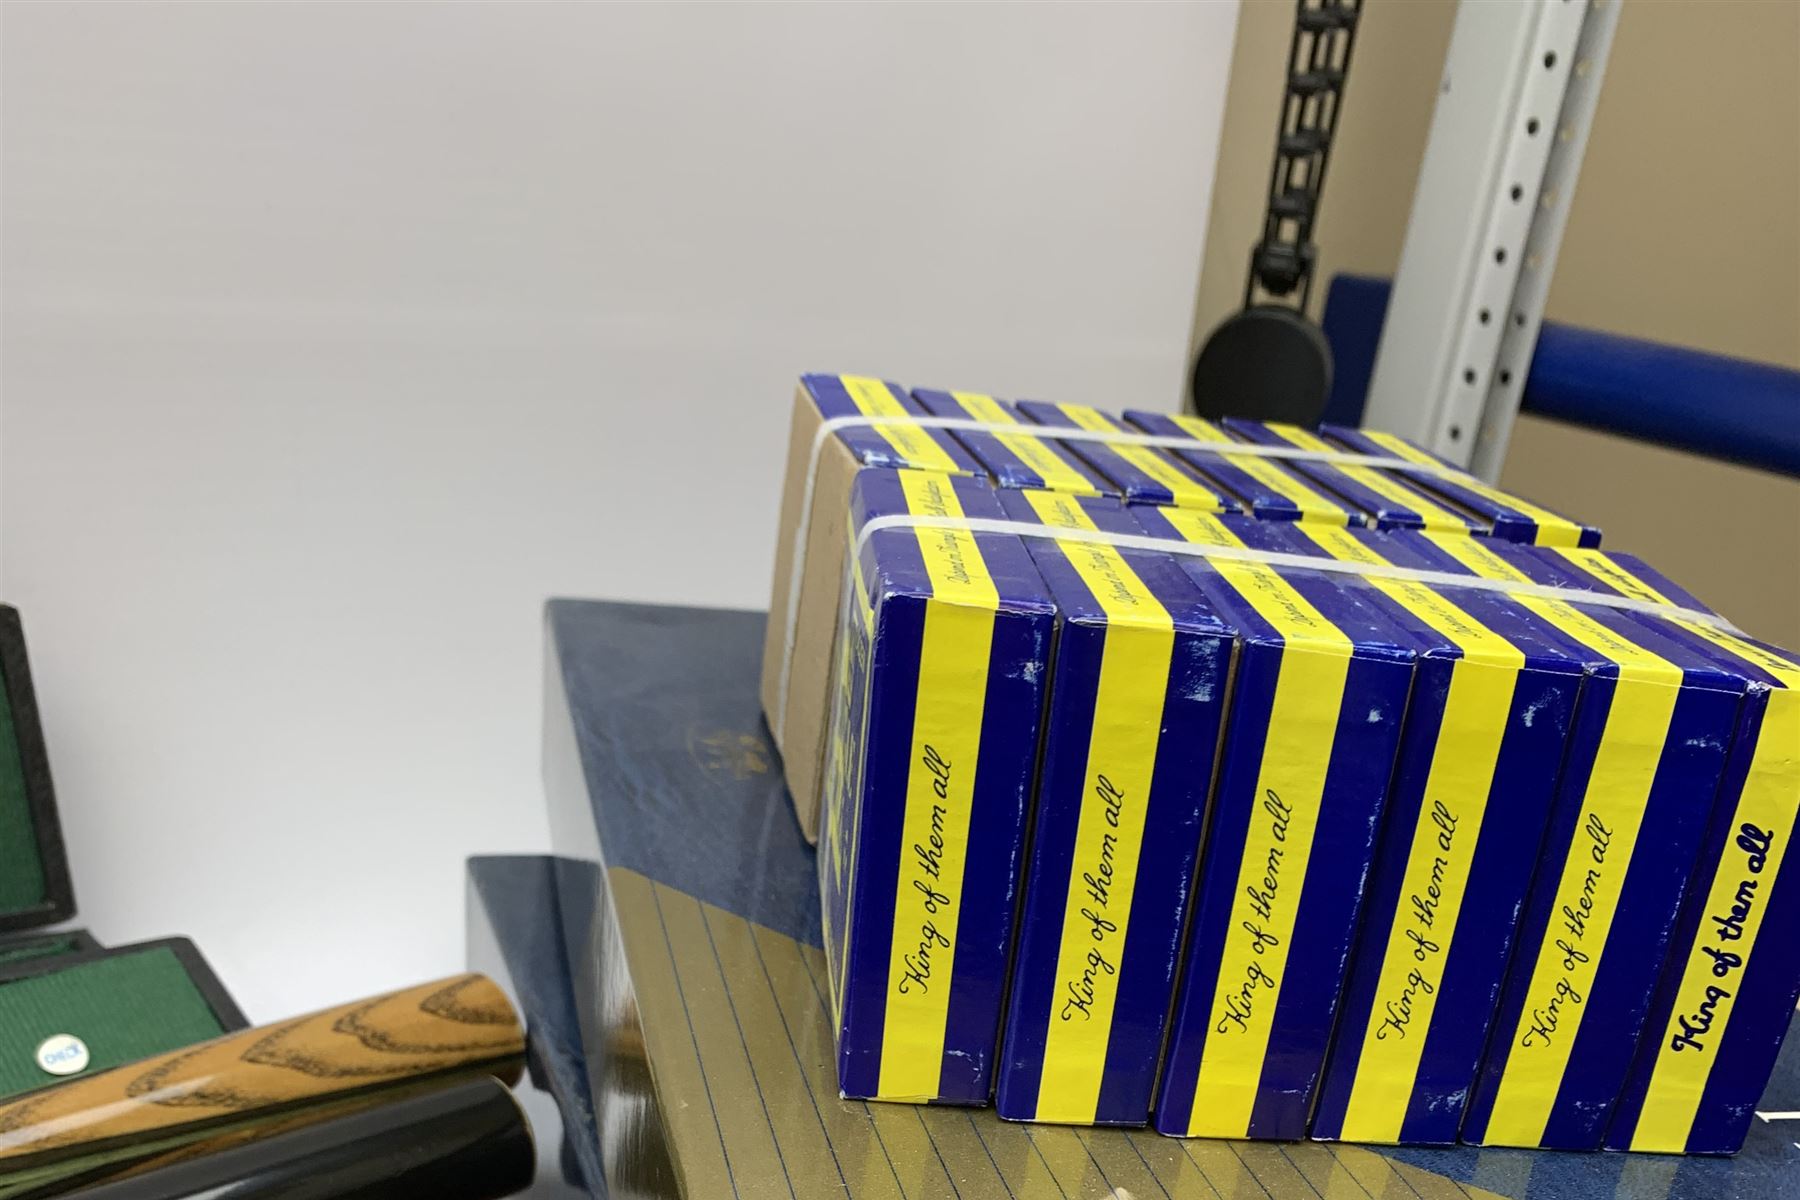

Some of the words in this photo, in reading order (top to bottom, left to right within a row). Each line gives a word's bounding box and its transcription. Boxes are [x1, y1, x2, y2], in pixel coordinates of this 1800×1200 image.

[922, 744, 952, 800] all
[1096, 774, 1125, 829] all
[914, 804, 947, 882] them
[1263, 788, 1293, 843] all
[1431, 799, 1459, 852] all
[1585, 813, 1614, 864] all
[1083, 833, 1118, 908] them
[1735, 822, 1775, 874] all
[913, 880, 951, 915] of
[1246, 847, 1285, 922] them
[1411, 857, 1449, 930] them
[1563, 869, 1601, 942] them
[1711, 880, 1759, 942] them
[1080, 907, 1117, 942] of
[1243, 921, 1279, 955] of
[1406, 929, 1440, 962] of
[899, 921, 951, 994] King
[1061, 947, 1115, 1021] King
[1556, 939, 1590, 972] of
[1701, 946, 1743, 978] of
[1217, 961, 1275, 1034] King
[1376, 967, 1434, 1040] King
[1521, 975, 1582, 1048] King
[1670, 985, 1732, 1052] King
